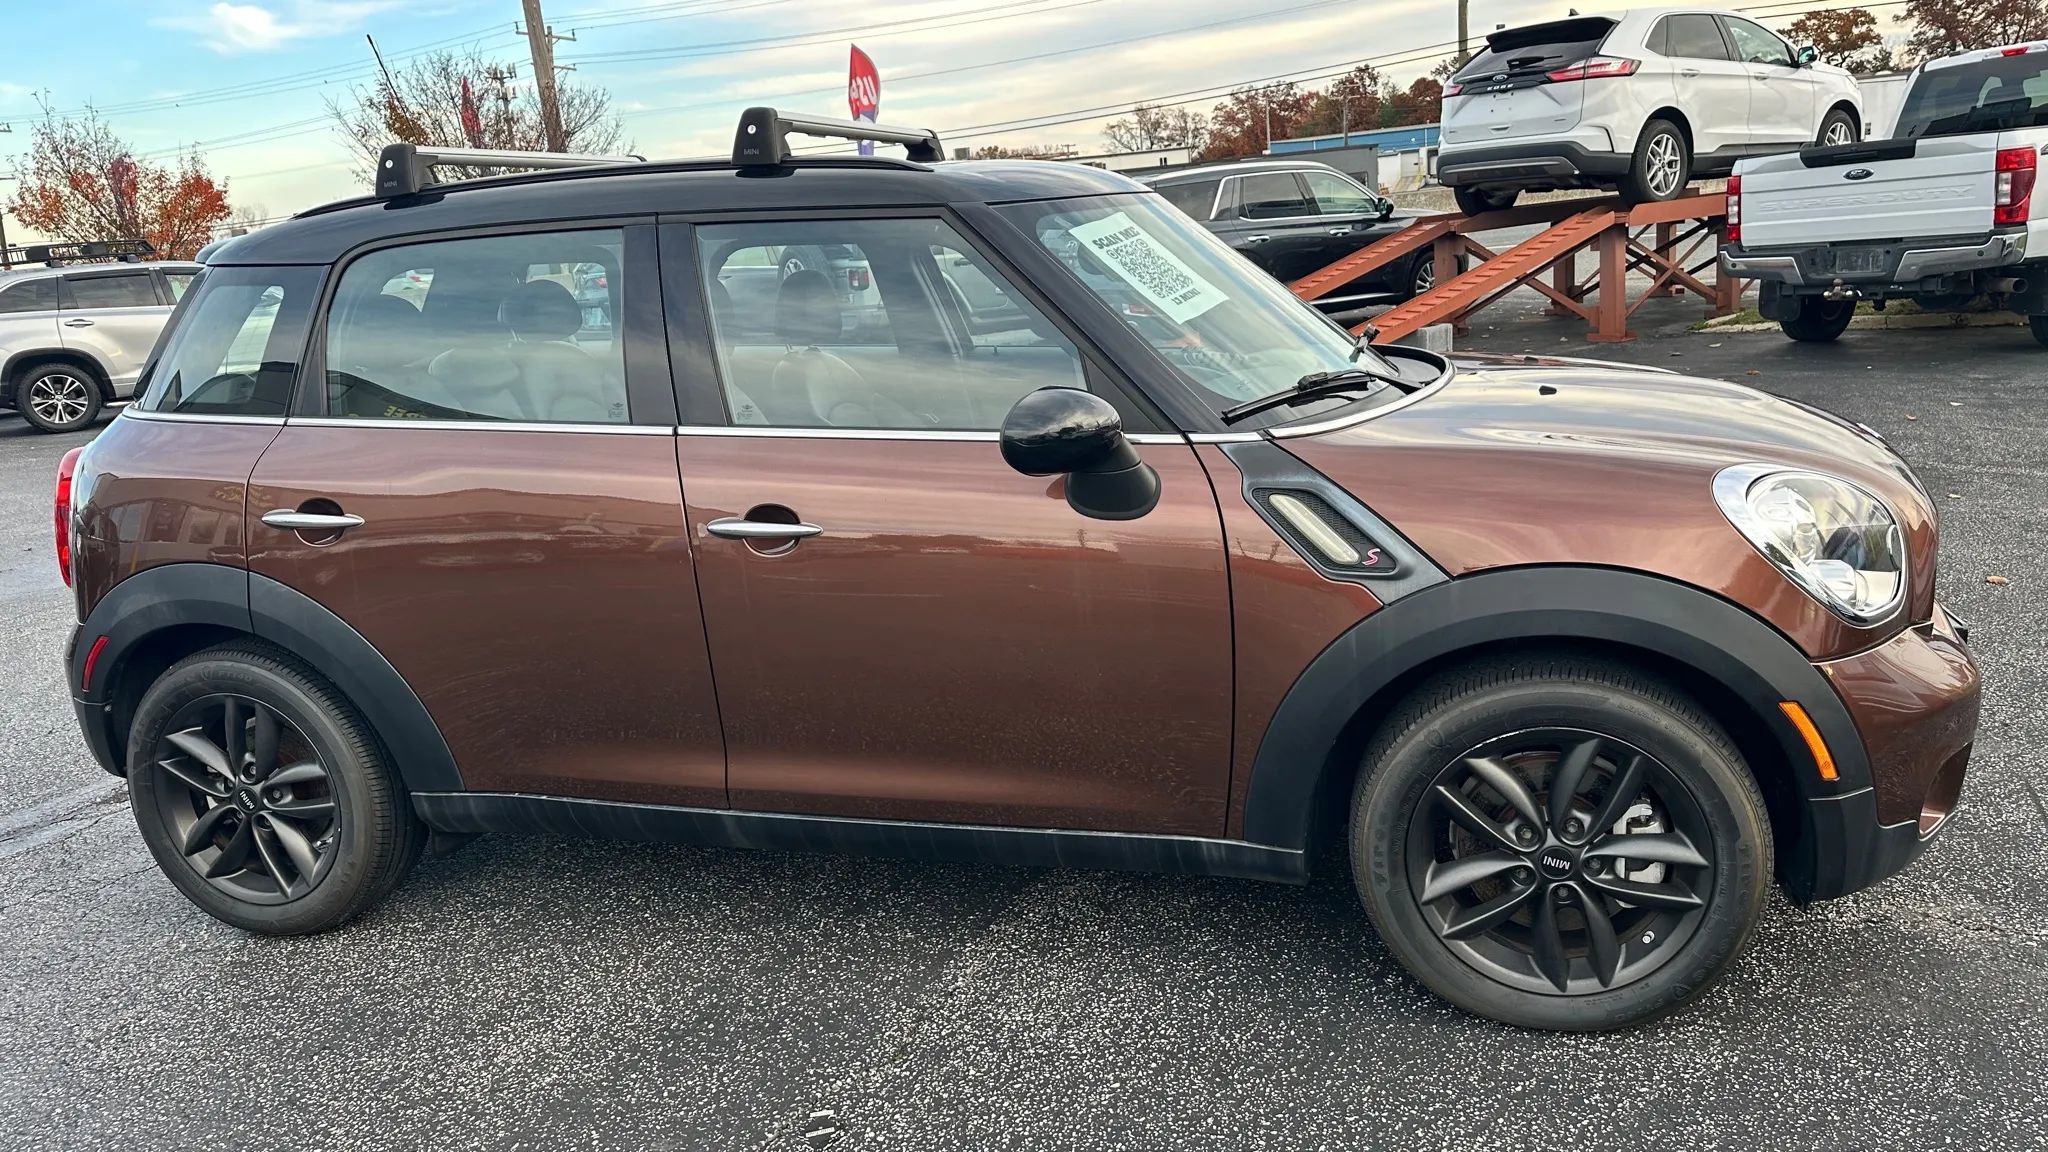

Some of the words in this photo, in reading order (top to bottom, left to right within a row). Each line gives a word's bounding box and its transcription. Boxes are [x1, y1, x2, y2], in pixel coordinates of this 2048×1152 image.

[743, 148, 760, 156] MINI
[1760, 195, 1868, 212] SUPER
[1875, 186, 1976, 203] DUTY
[1092, 234, 1122, 250] SCAN
[1120, 226, 1141, 241] ME
[1181, 288, 1201, 303] MINI
[1362, 548, 1380, 565] S
[240, 790, 255, 809] MINI
[1543, 855, 1570, 870] MINI
